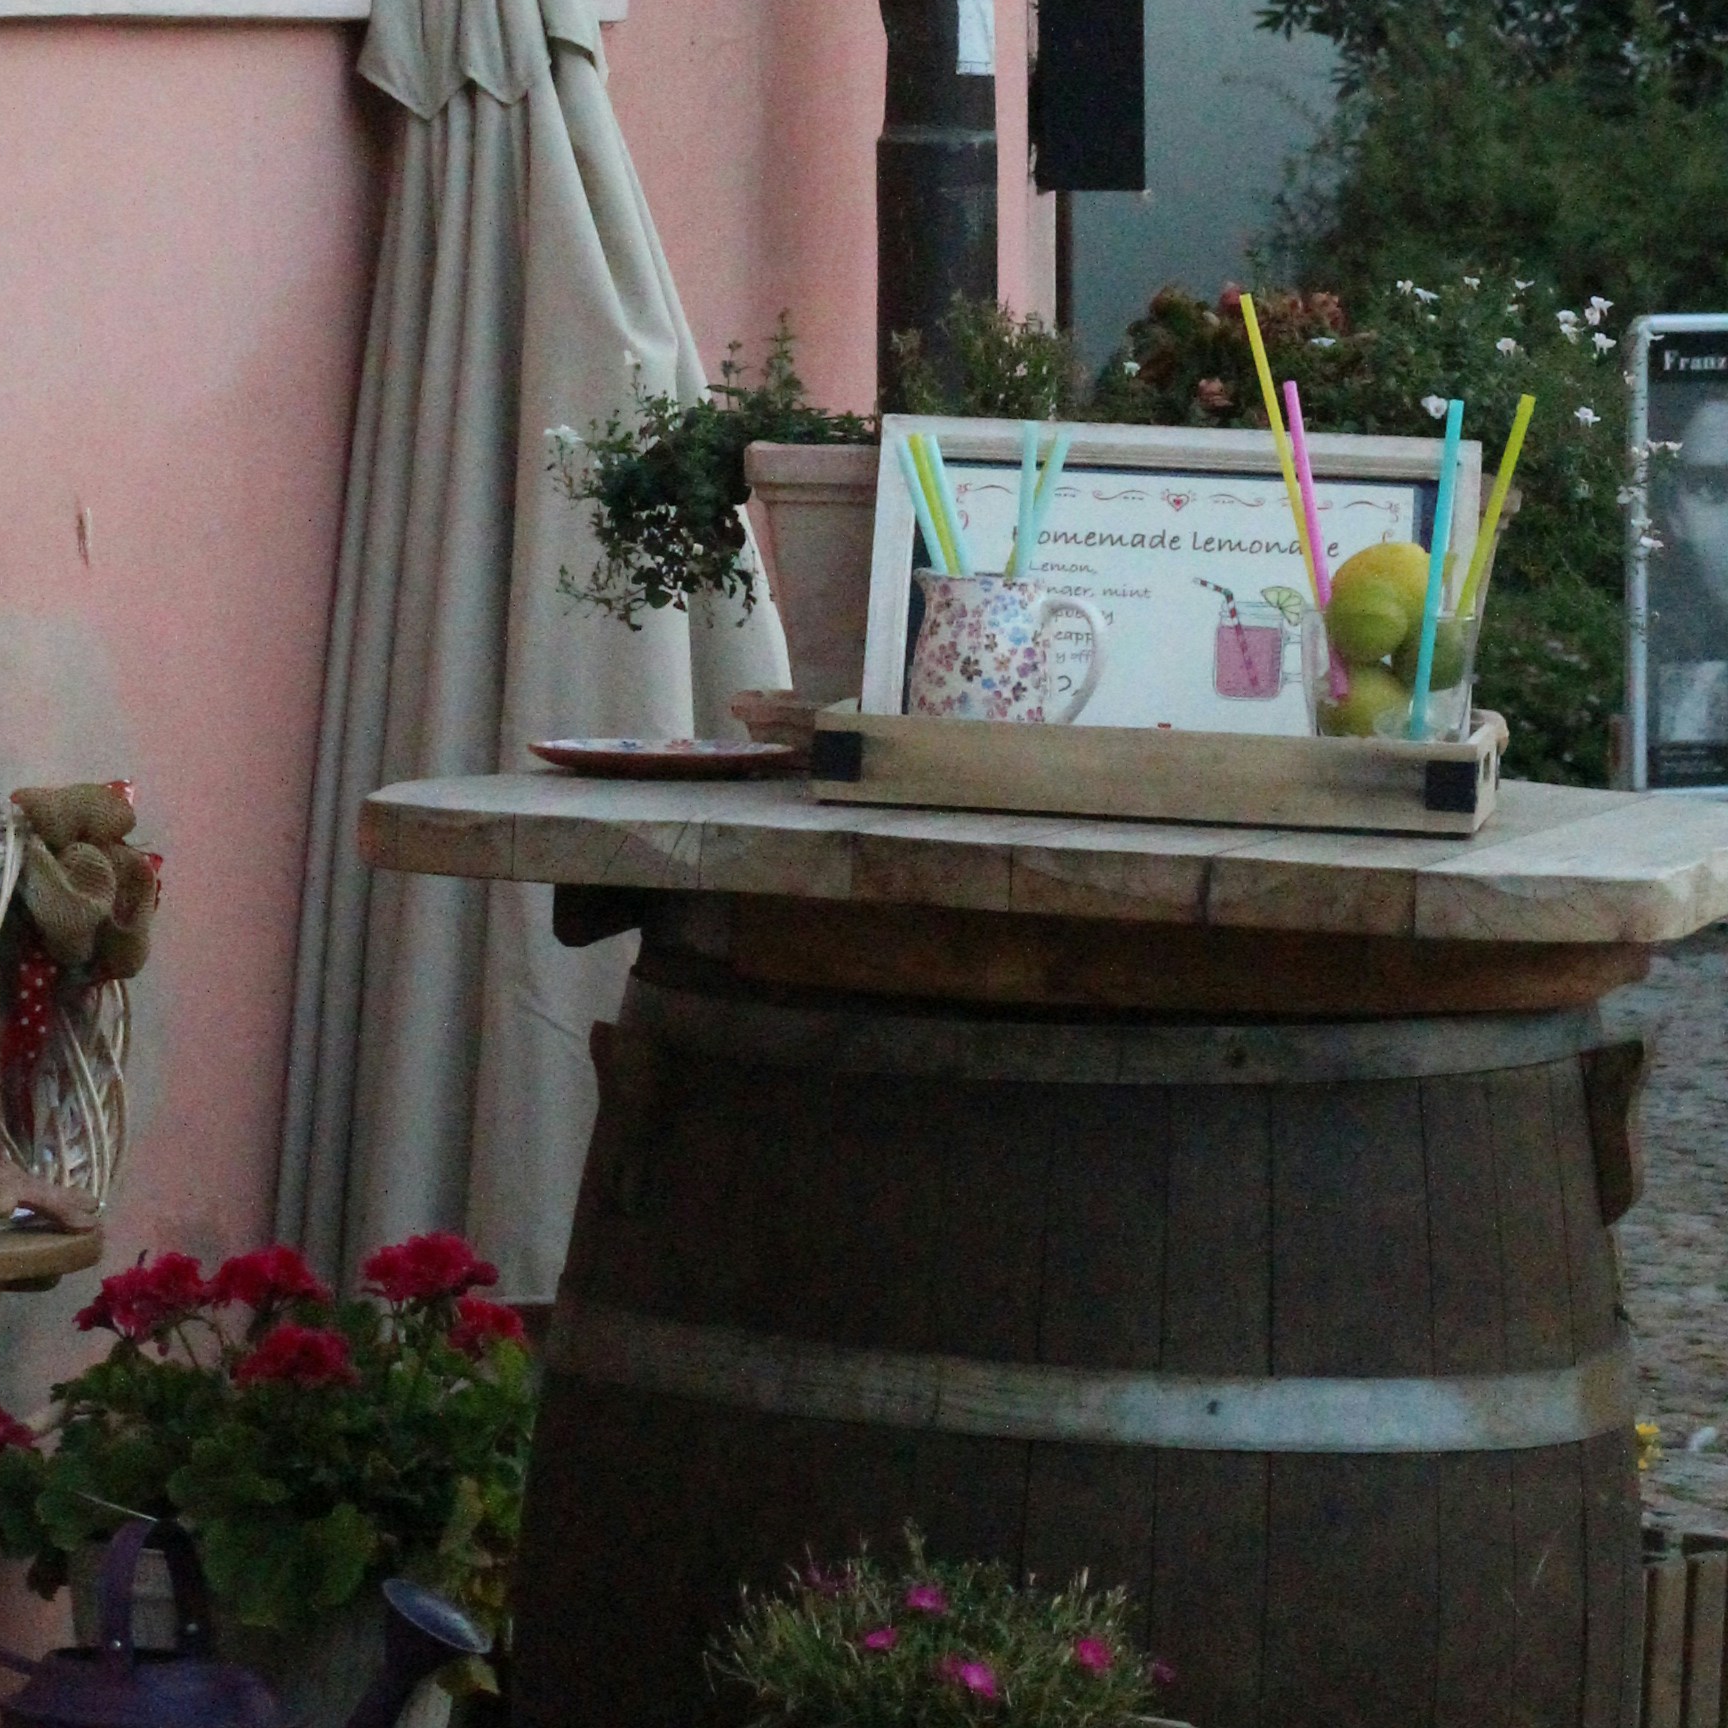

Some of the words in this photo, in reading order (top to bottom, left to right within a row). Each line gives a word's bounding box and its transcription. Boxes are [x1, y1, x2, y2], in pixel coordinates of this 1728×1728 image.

[1011, 525, 1182, 552] omemade
[1192, 530, 1340, 558] lemonae
[1102, 585, 1152, 601] mint
